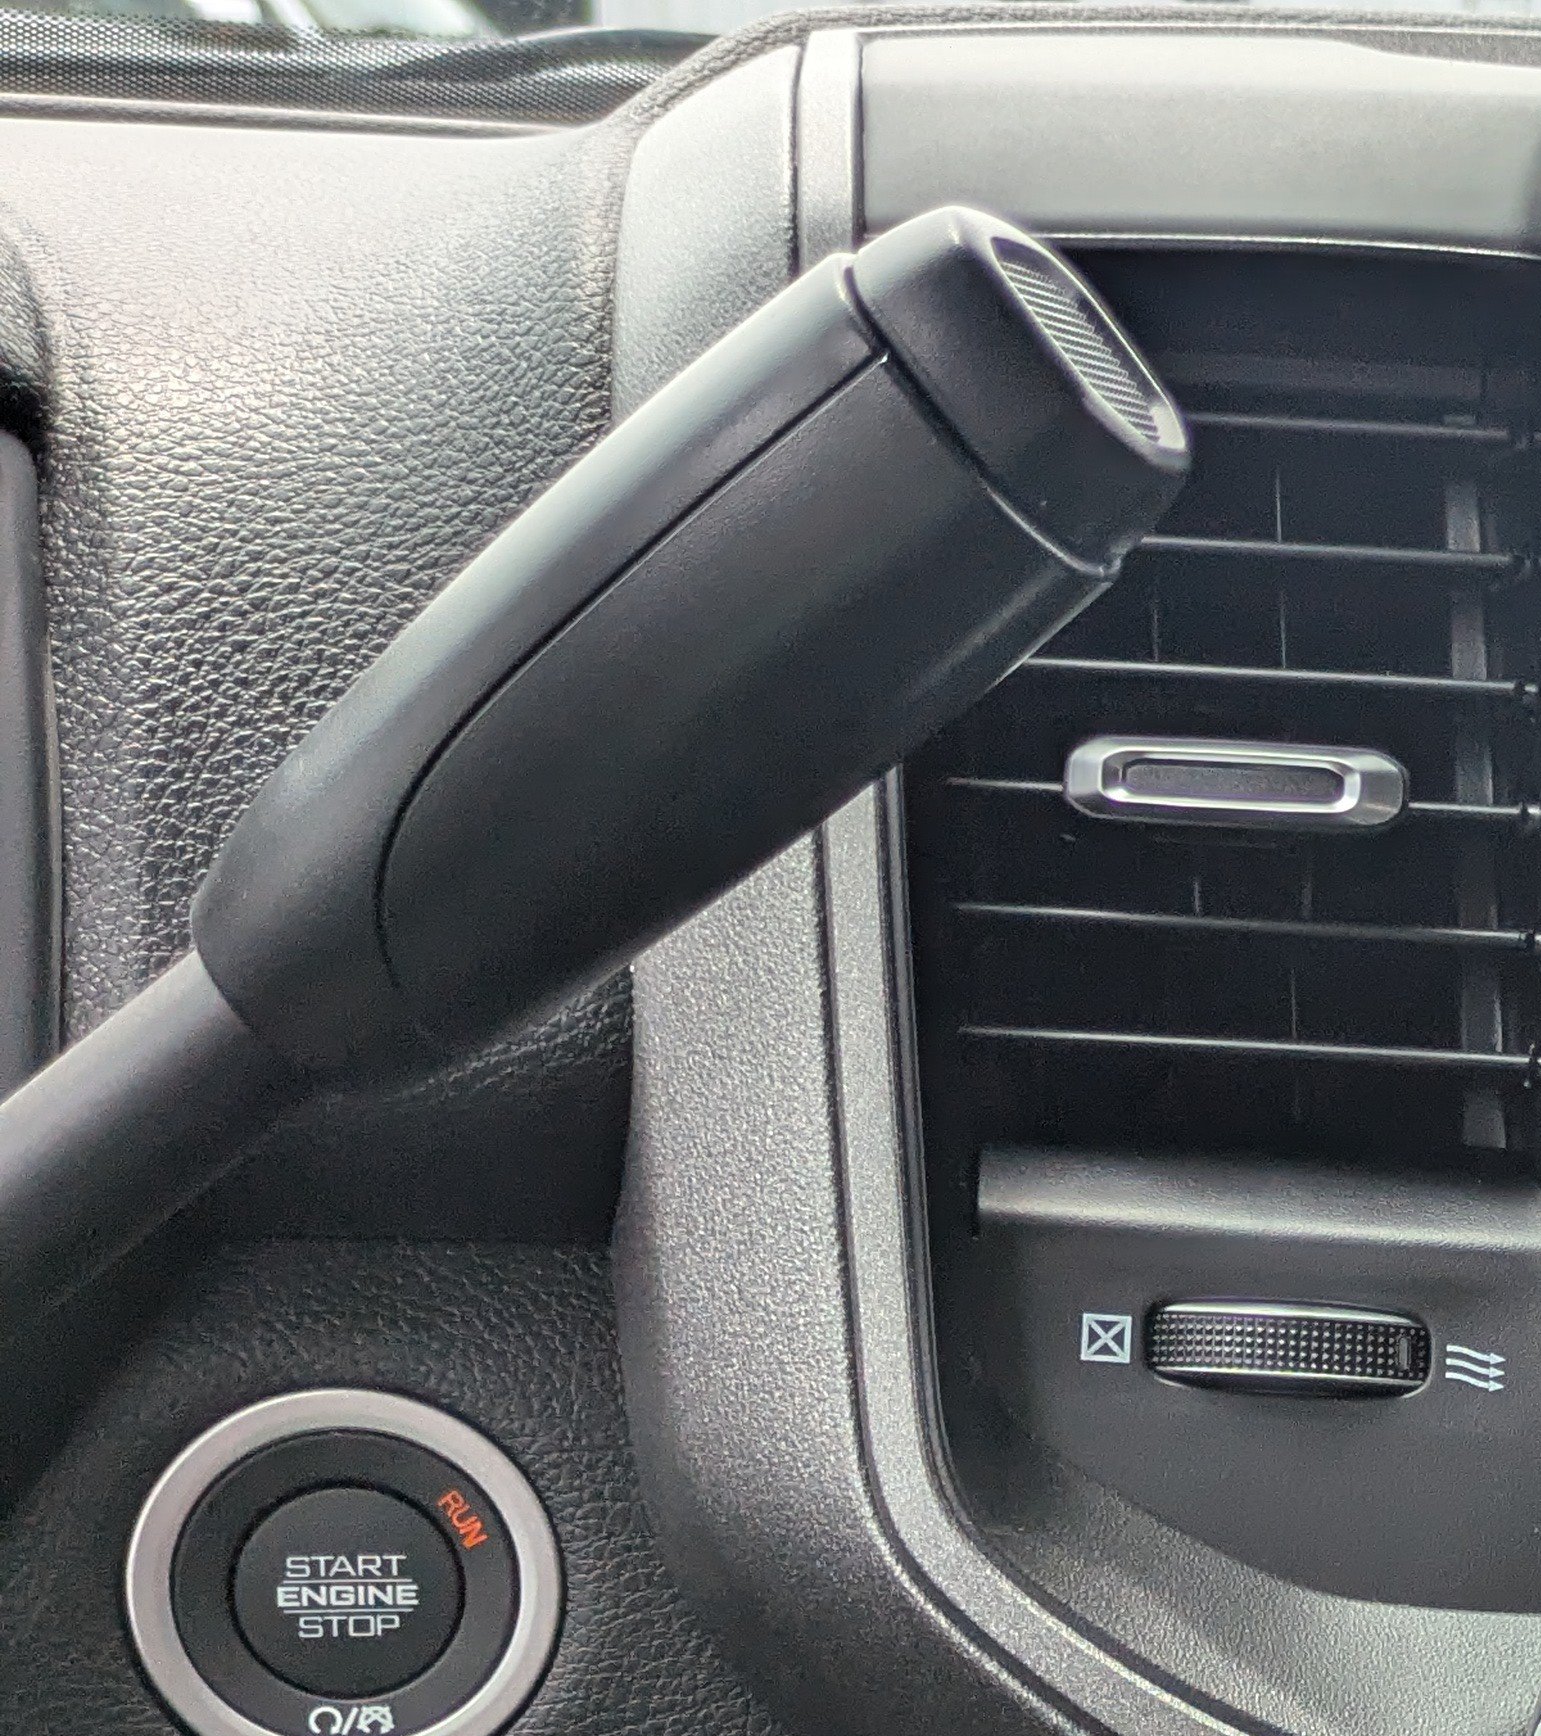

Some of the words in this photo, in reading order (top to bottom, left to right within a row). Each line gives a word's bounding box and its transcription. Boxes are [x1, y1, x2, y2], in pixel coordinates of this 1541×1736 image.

[438, 1490, 488, 1549] RUN
[285, 1554, 407, 1578] START
[276, 1583, 420, 1608] ENGINE
[298, 1615, 400, 1638] STOP
